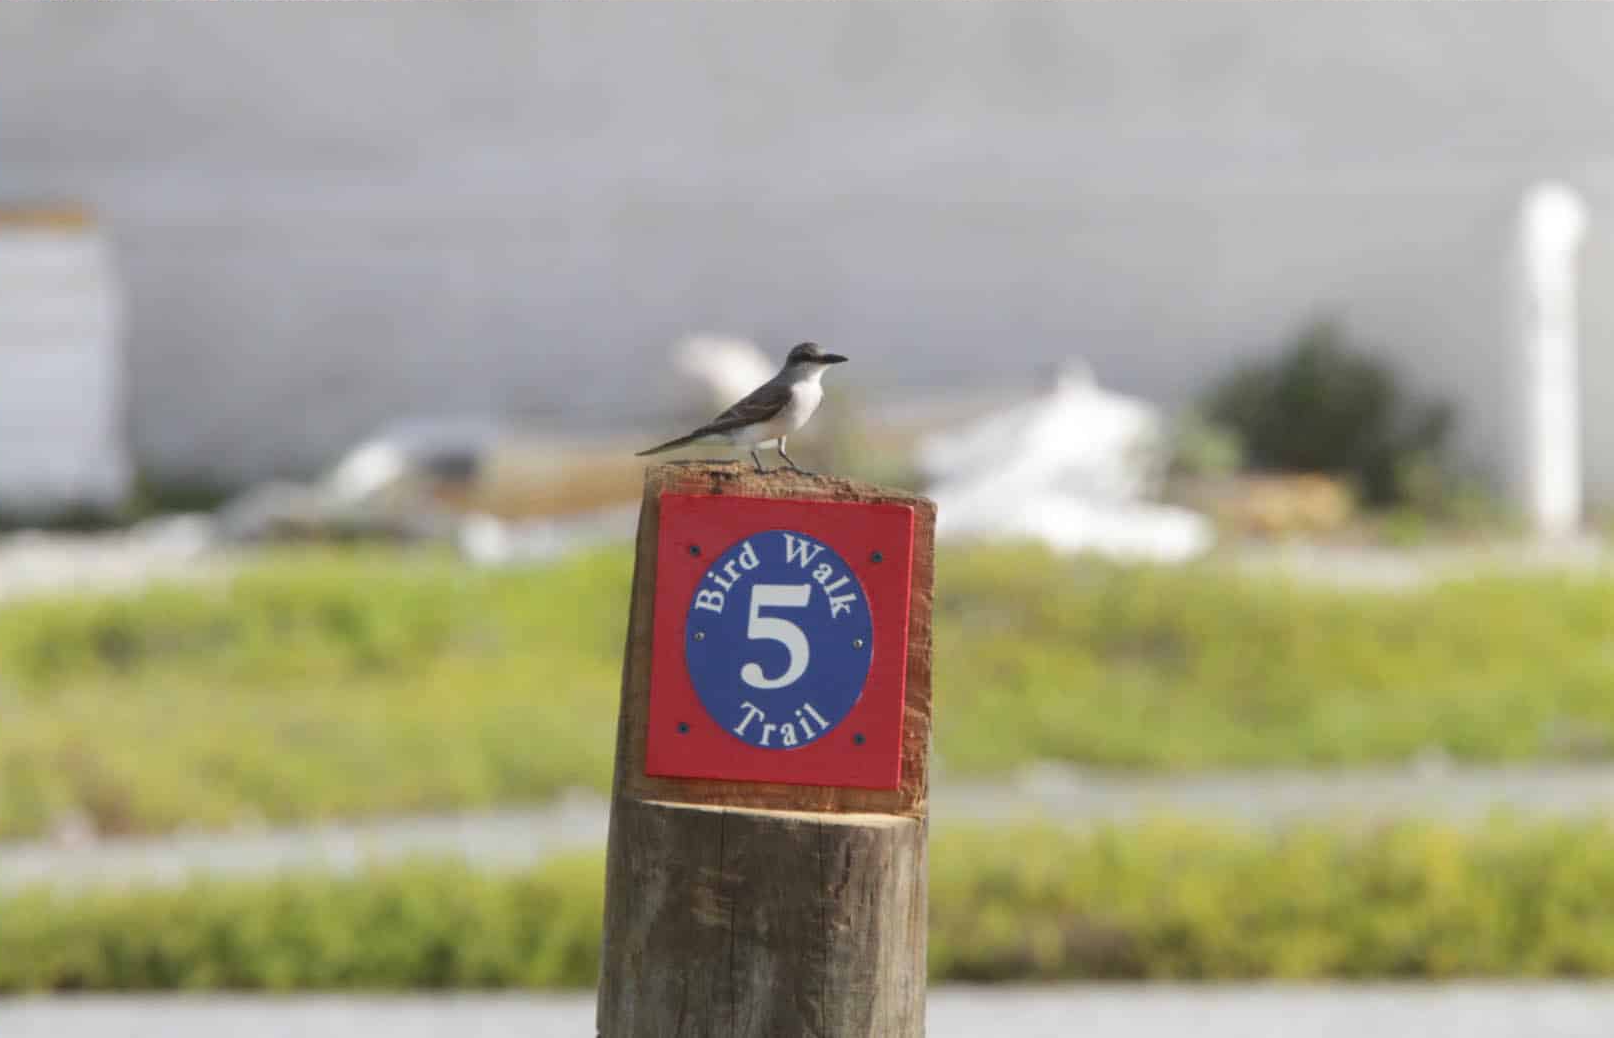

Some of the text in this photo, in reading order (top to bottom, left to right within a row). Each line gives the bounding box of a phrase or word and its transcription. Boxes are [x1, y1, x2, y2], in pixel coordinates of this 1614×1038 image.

[694, 533, 857, 618] Bird Walk
[740, 583, 811, 689] 5
[733, 701, 829, 746] Trail
